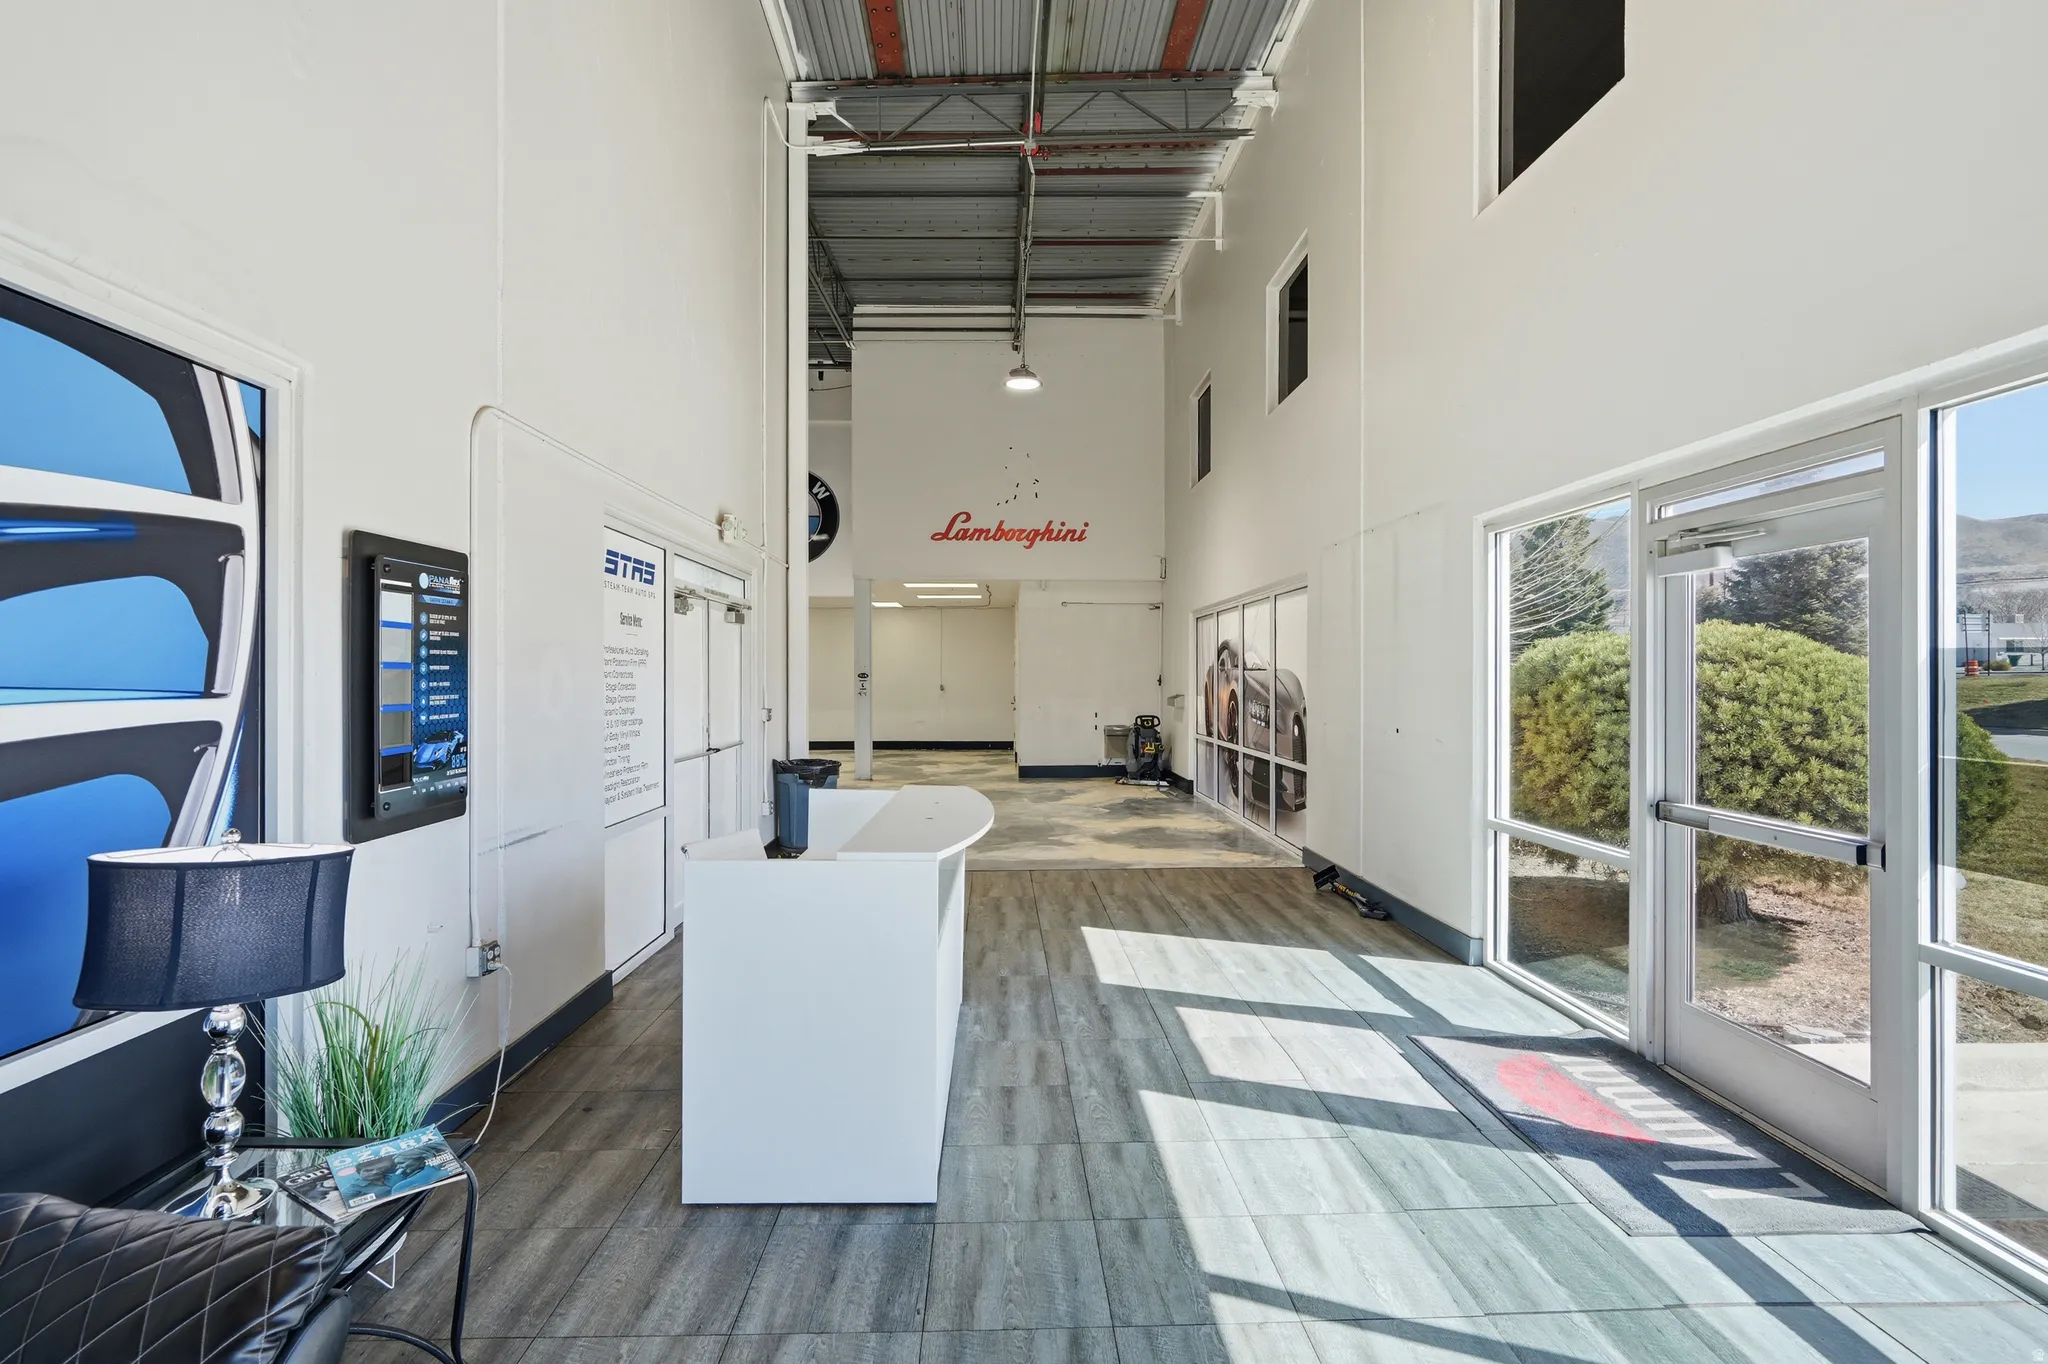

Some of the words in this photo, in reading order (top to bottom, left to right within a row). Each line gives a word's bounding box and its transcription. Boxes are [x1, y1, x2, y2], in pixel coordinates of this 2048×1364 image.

[931, 511, 1090, 550] Lamborghini
[604, 549, 656, 586] STAS
[604, 580, 620, 591] STEAM
[621, 584, 634, 594] TEAM
[635, 587, 647, 597] AUTO
[333, 1131, 438, 1167] OZARK
